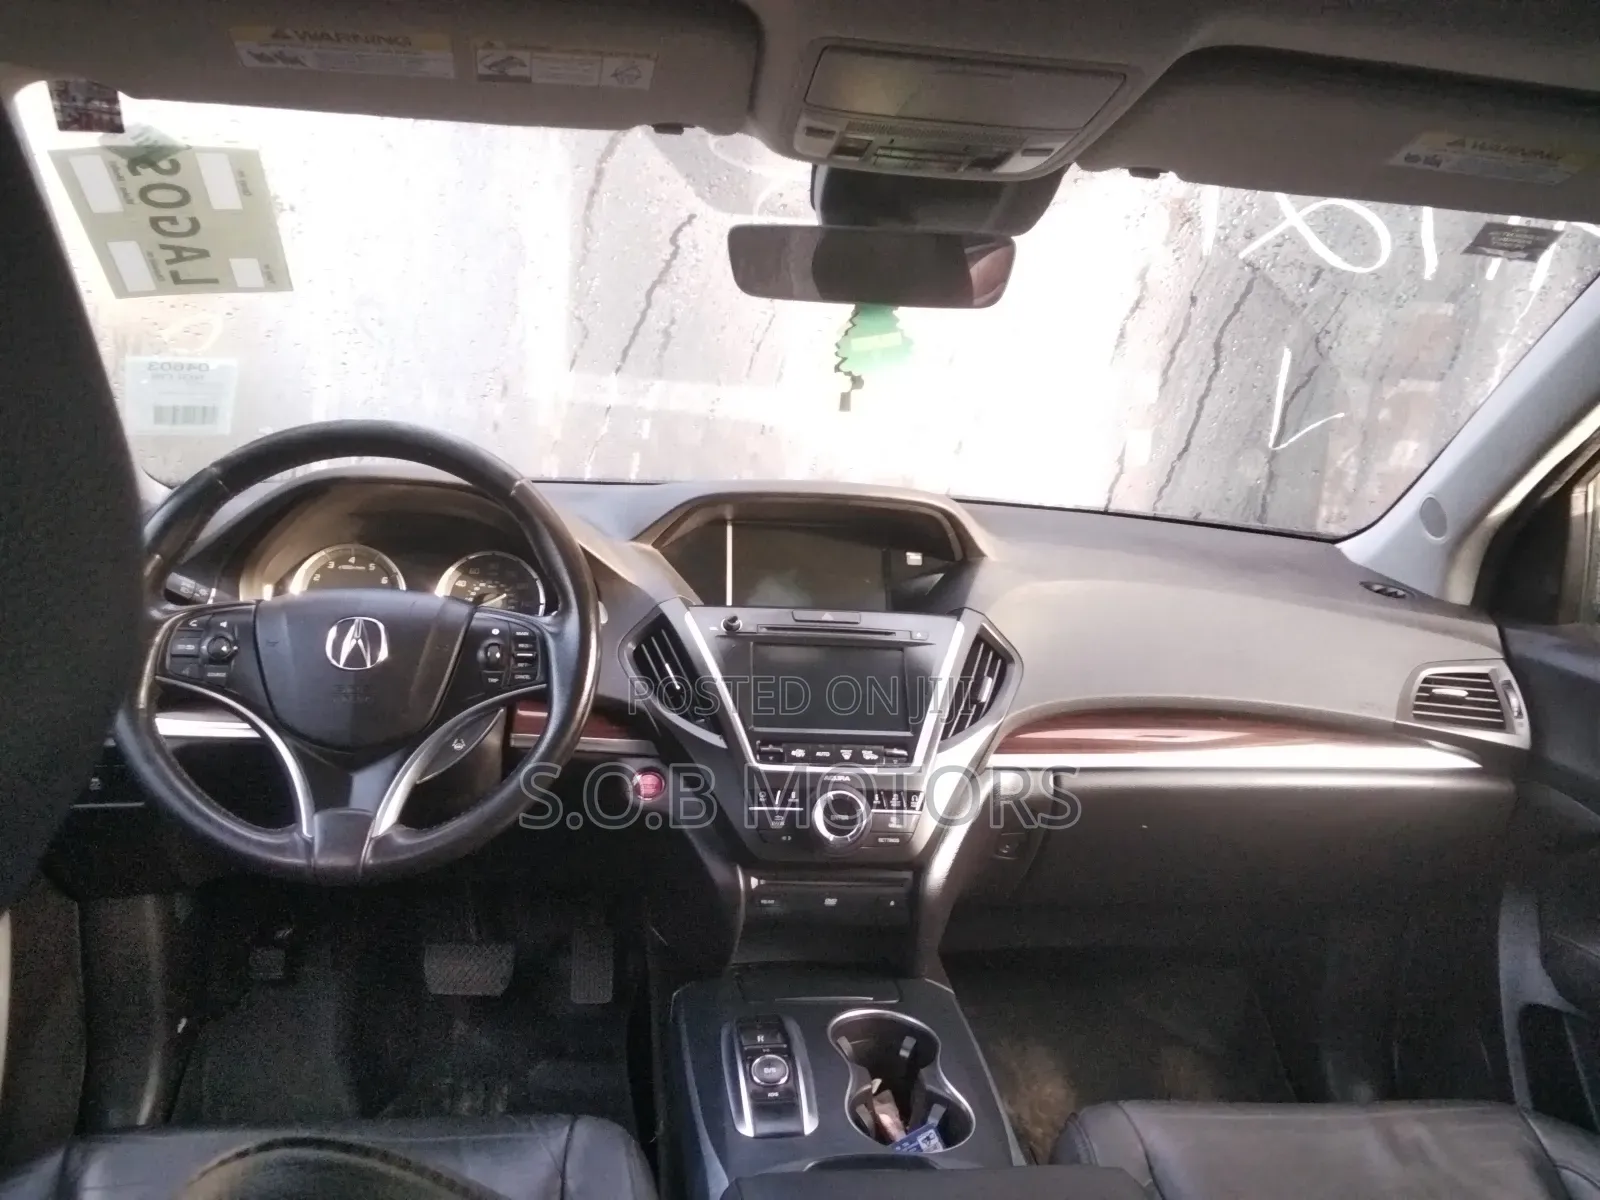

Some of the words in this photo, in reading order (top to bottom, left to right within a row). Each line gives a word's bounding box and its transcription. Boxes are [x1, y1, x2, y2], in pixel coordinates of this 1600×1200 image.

[348, 556, 356, 564] 4
[327, 561, 335, 569] 3
[368, 563, 376, 571] 5
[313, 573, 321, 581] 2
[381, 576, 389, 584] 6
